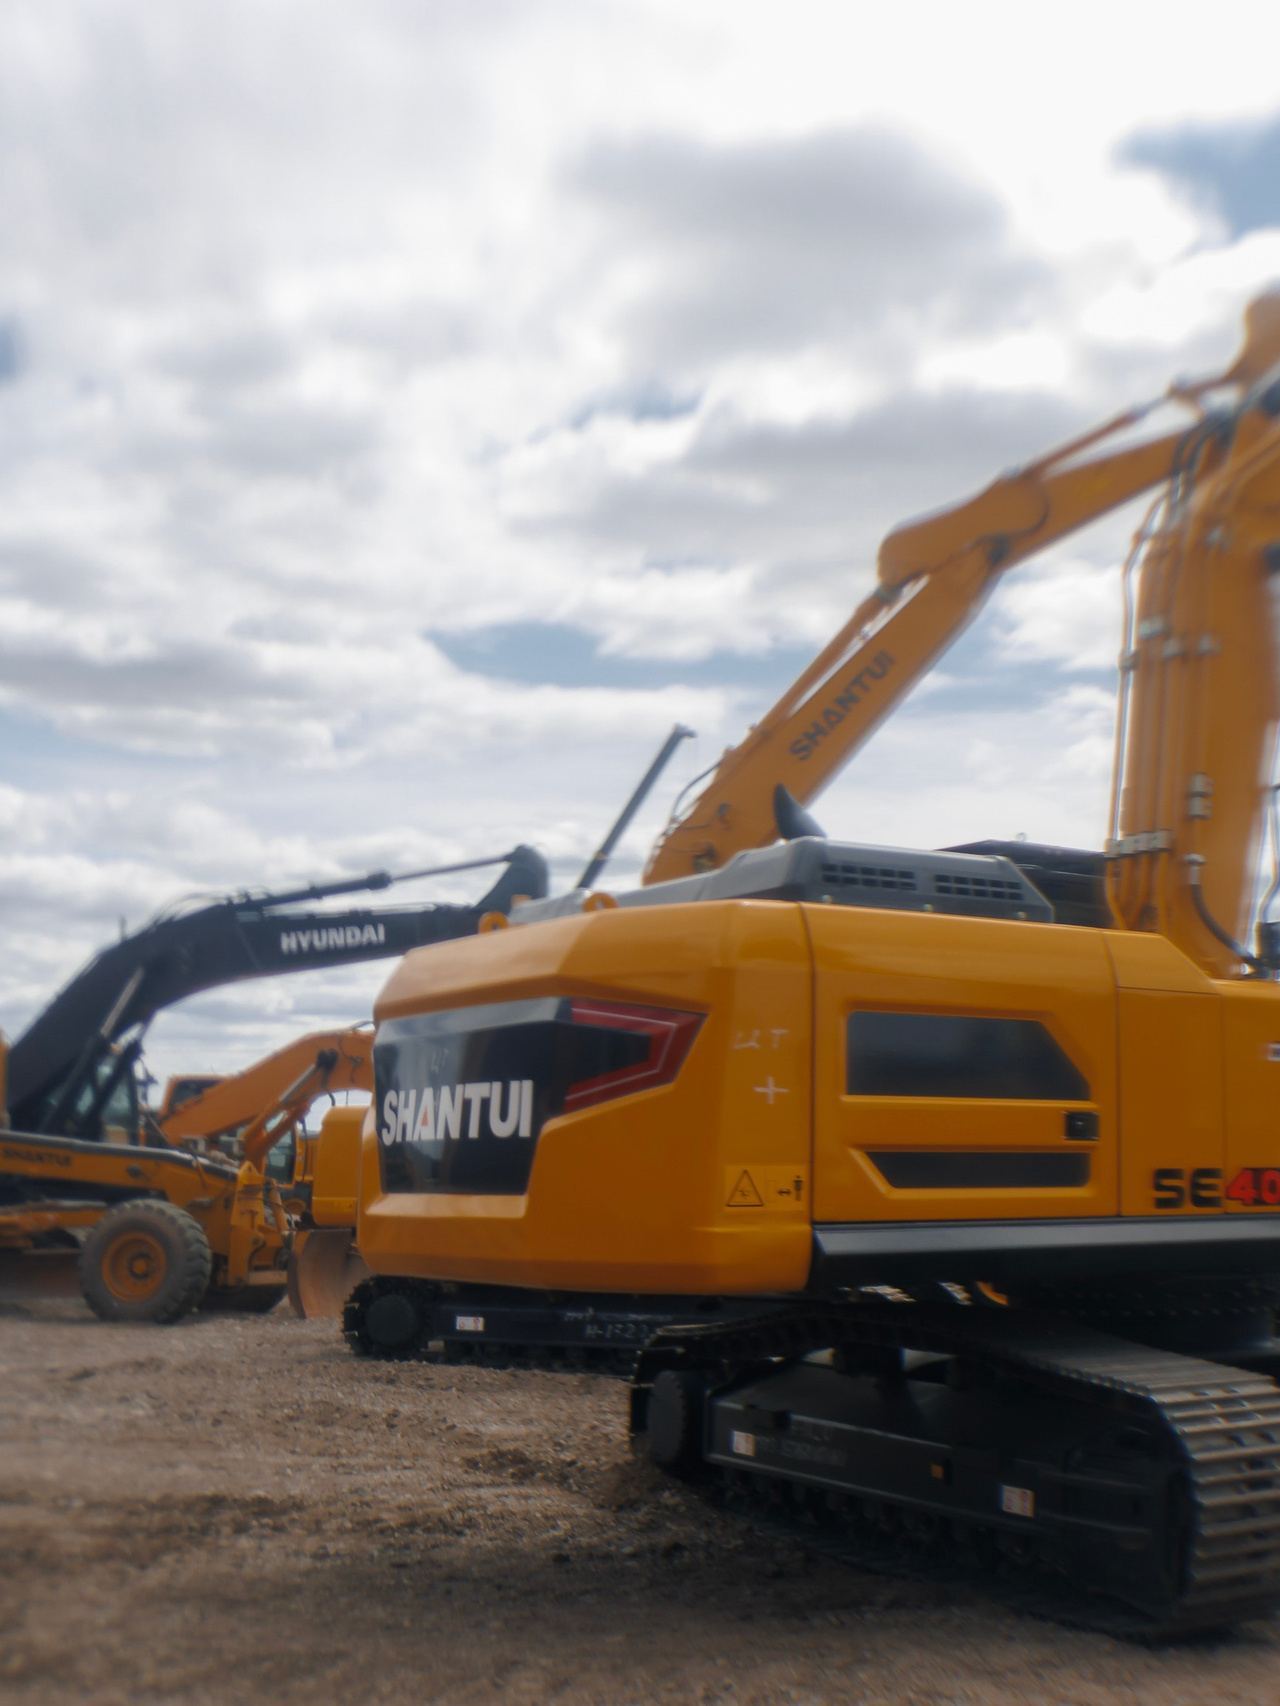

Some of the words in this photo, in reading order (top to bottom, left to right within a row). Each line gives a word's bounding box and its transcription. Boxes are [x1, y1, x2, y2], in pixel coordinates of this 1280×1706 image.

[790, 650, 896, 761] SHANTUI
[281, 923, 385, 955] HYUNDAI
[382, 1079, 534, 1146] SHANTUI
